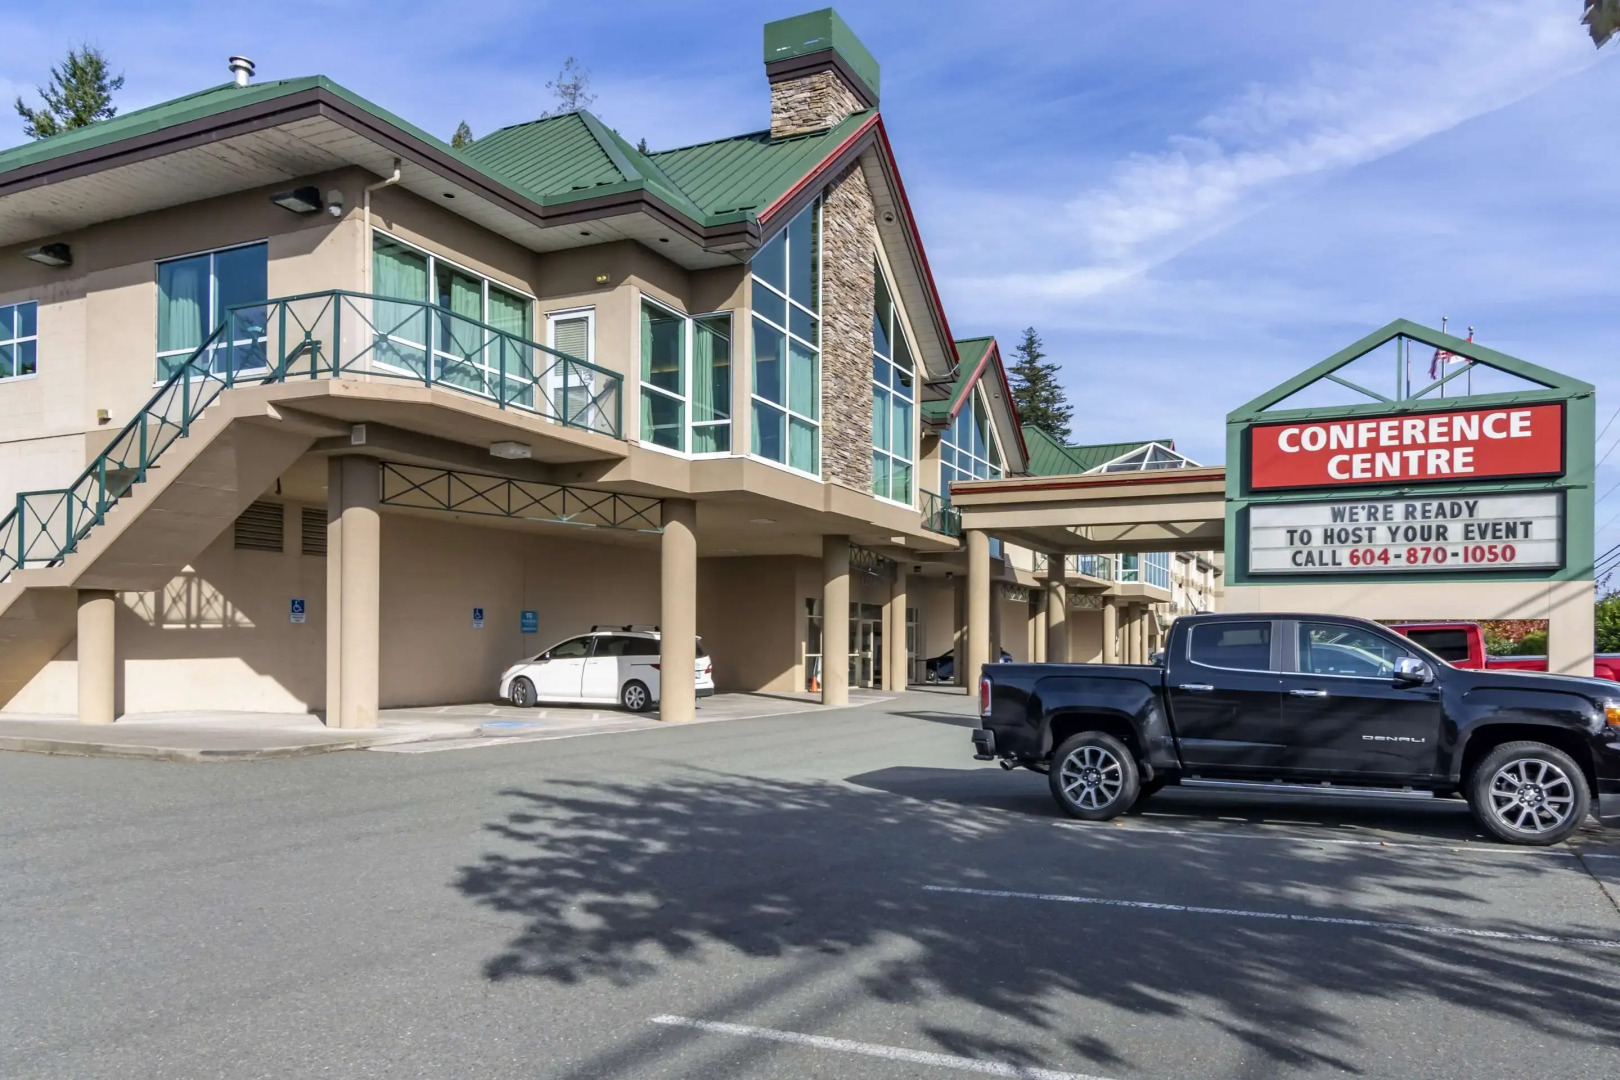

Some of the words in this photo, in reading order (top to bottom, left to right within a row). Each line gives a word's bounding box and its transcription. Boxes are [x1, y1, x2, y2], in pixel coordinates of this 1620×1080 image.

[1278, 411, 1532, 453] CONFERENCE
[1327, 446, 1474, 480] CENTRE
[1331, 504, 1394, 523] WE'RE
[1404, 500, 1479, 521] READY
[1287, 529, 1312, 546] TO
[1323, 526, 1376, 545] HOST
[1388, 524, 1448, 543] YOUR
[1463, 521, 1532, 541] EVENT
[1291, 549, 1342, 567] CALL
[1349, 544, 1516, 566] 604-870-1050
[1362, 735, 1425, 743] DENALI
